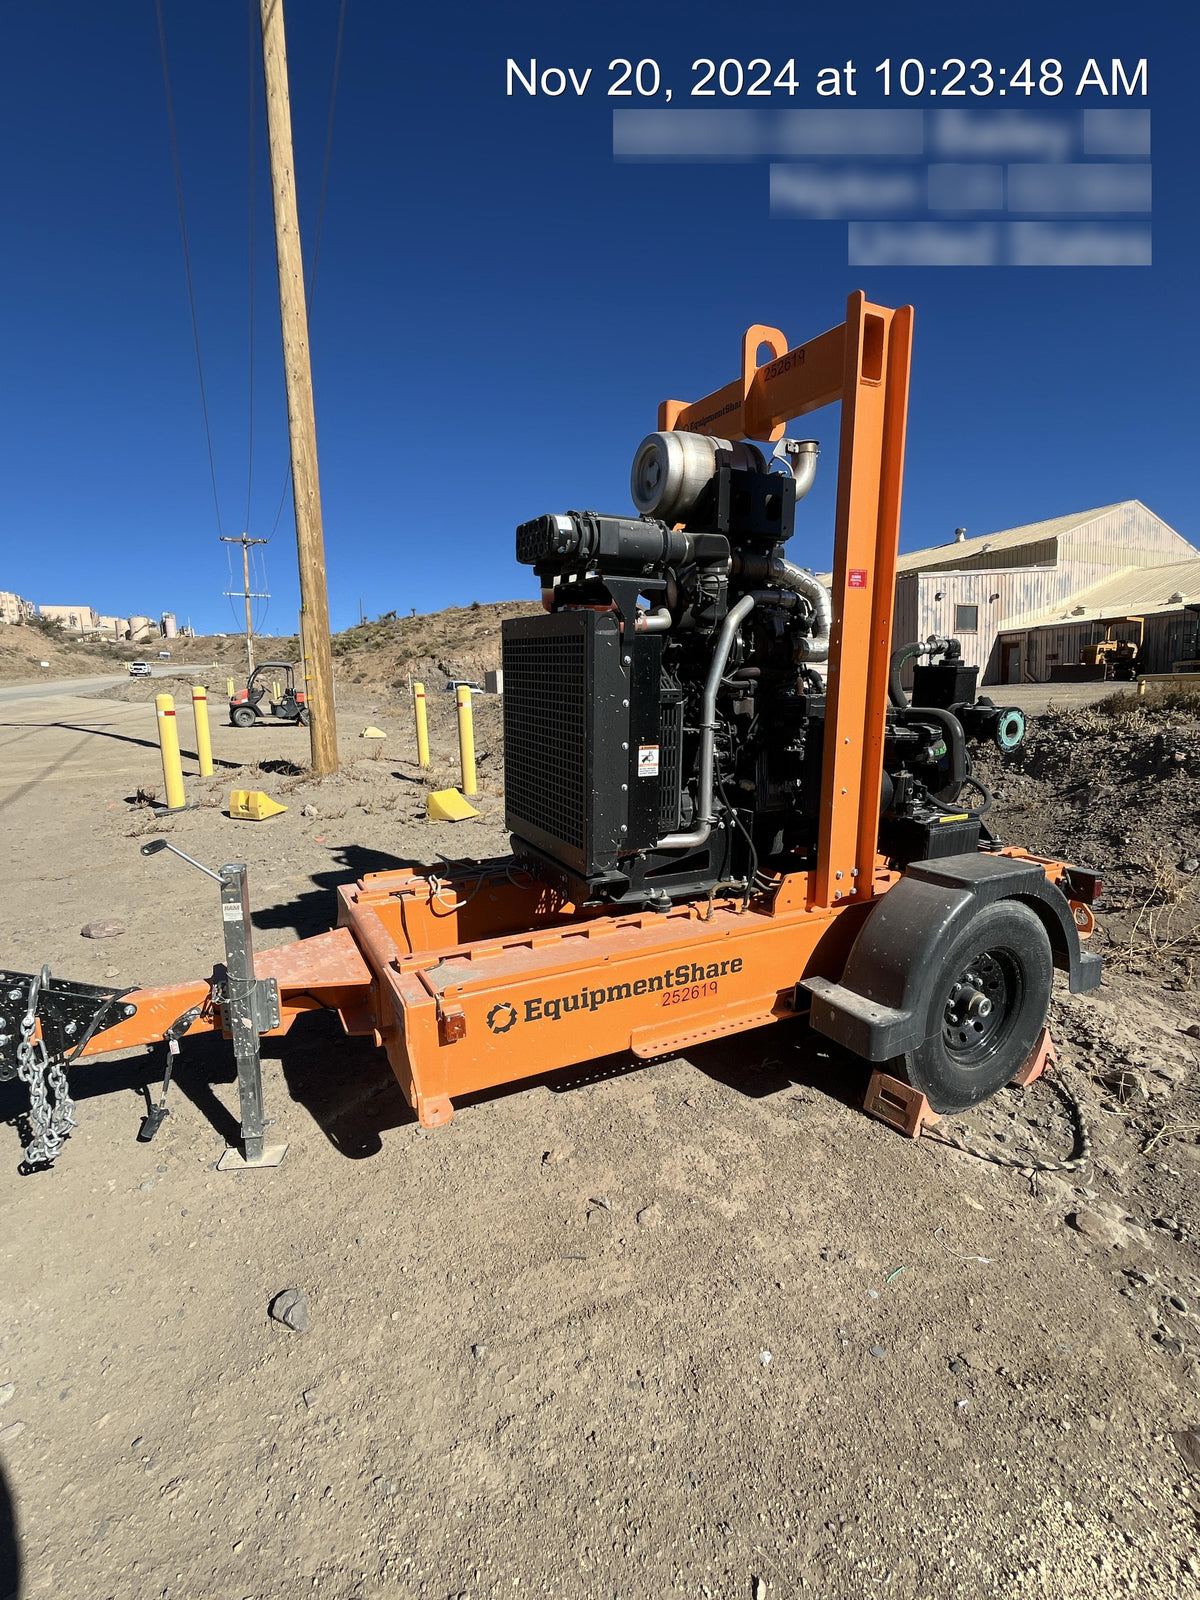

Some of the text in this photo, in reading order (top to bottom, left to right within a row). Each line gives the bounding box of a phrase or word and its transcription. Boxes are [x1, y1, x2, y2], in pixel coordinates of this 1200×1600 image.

[764, 349, 805, 381] 252619
[690, 400, 742, 430] EquipmentShar
[524, 957, 743, 1022] EquipmentShare
[661, 981, 718, 1007] 252619
